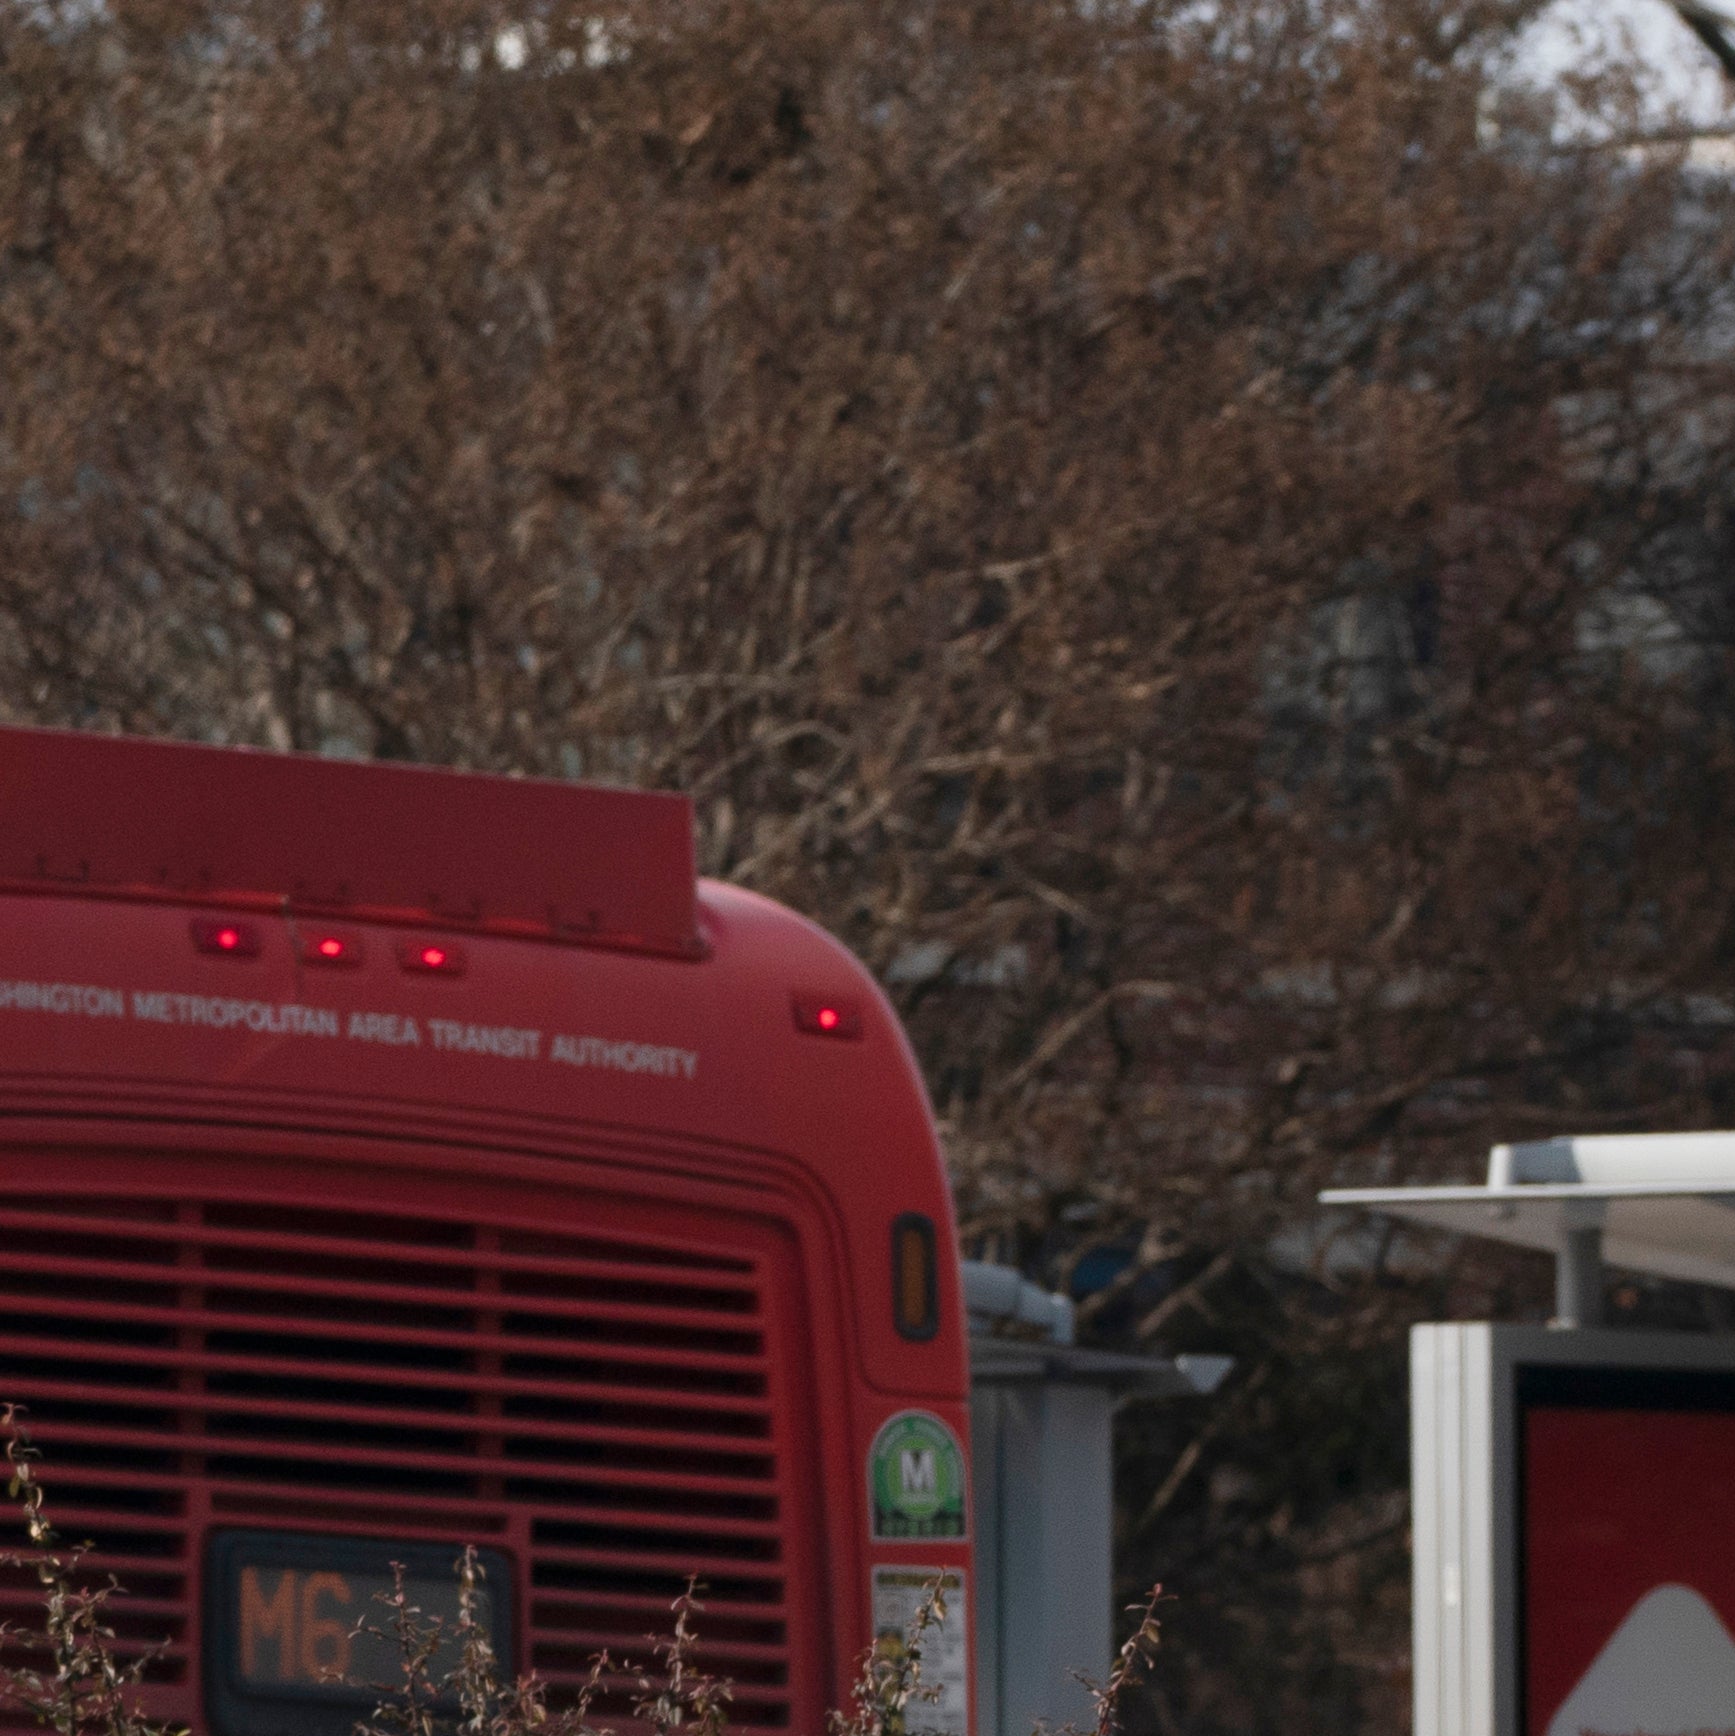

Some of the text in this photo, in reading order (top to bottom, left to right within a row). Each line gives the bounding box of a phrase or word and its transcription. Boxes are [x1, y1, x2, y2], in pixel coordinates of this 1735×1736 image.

[132, 990, 339, 1037] METROPOLITAN
[348, 1012, 420, 1047] AREA
[428, 1018, 542, 1060] TRANSIT
[550, 1033, 697, 1079] AUTHORITY
[239, 1566, 352, 1683] M6
